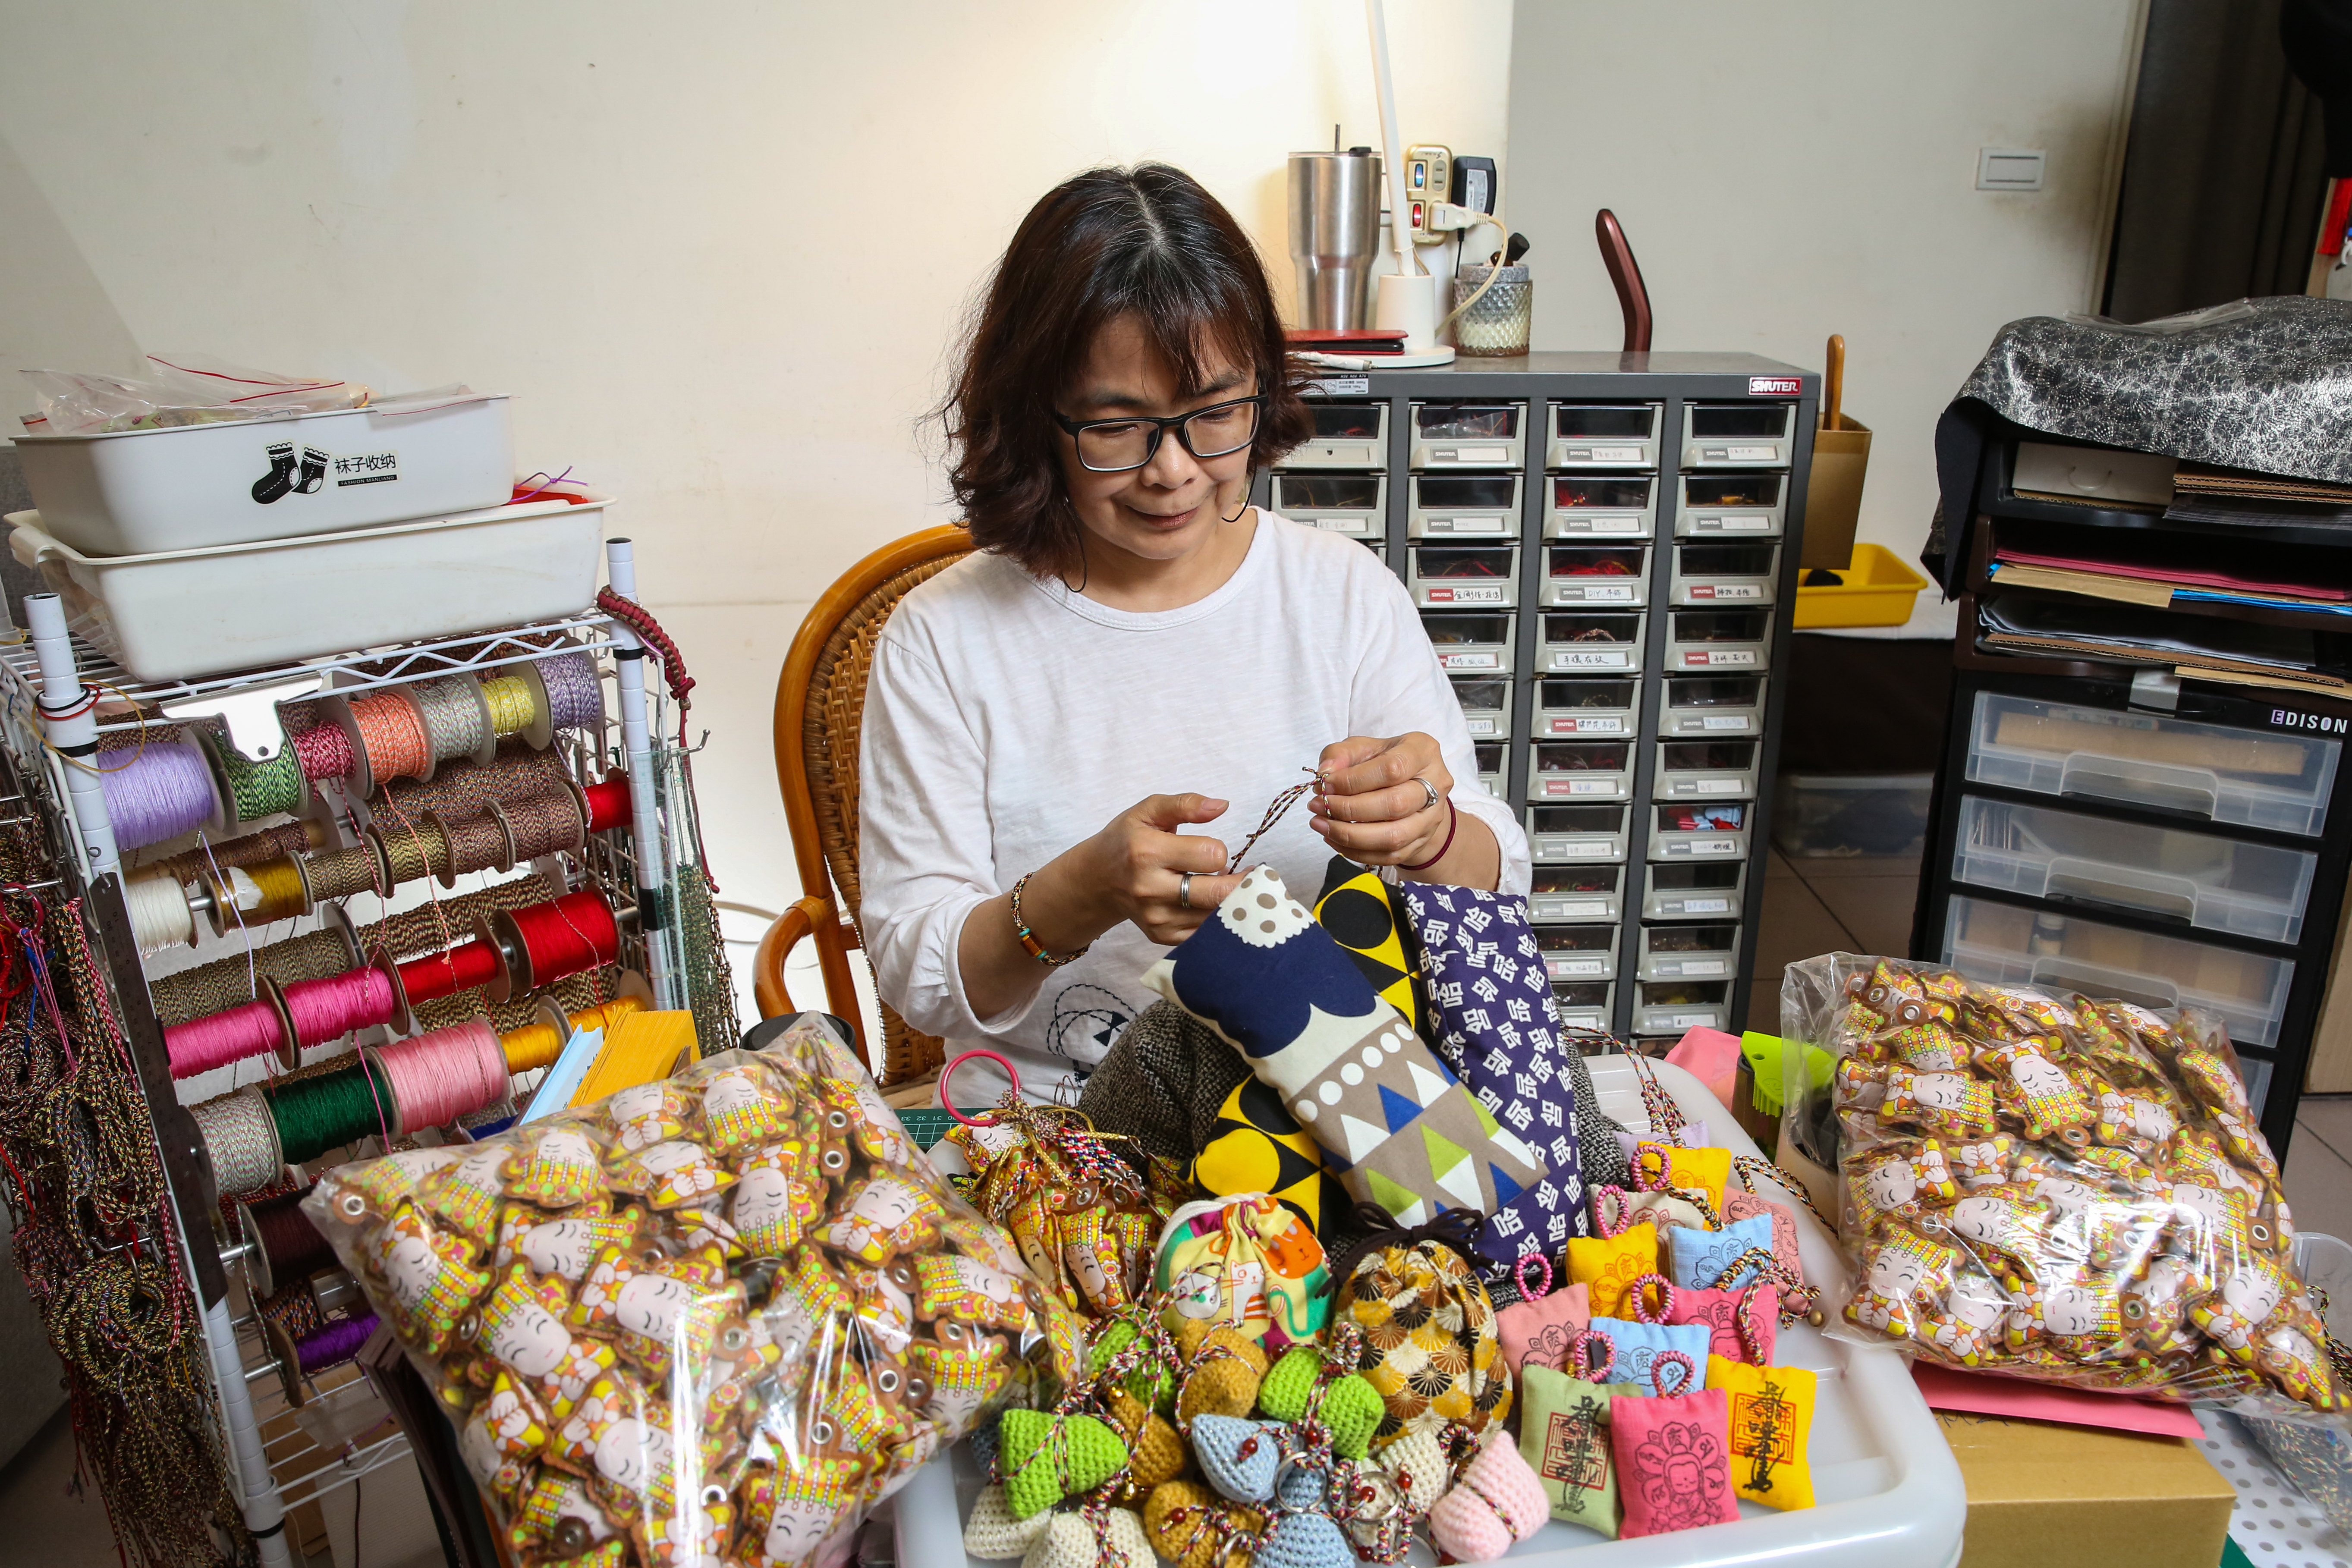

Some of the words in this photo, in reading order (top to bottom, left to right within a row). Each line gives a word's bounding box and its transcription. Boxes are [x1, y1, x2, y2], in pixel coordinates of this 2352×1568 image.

[1750, 380, 1799, 393] SHUTER
[334, 453, 396, 475] 袜子收纳
[2270, 710, 2348, 733] EDISON
